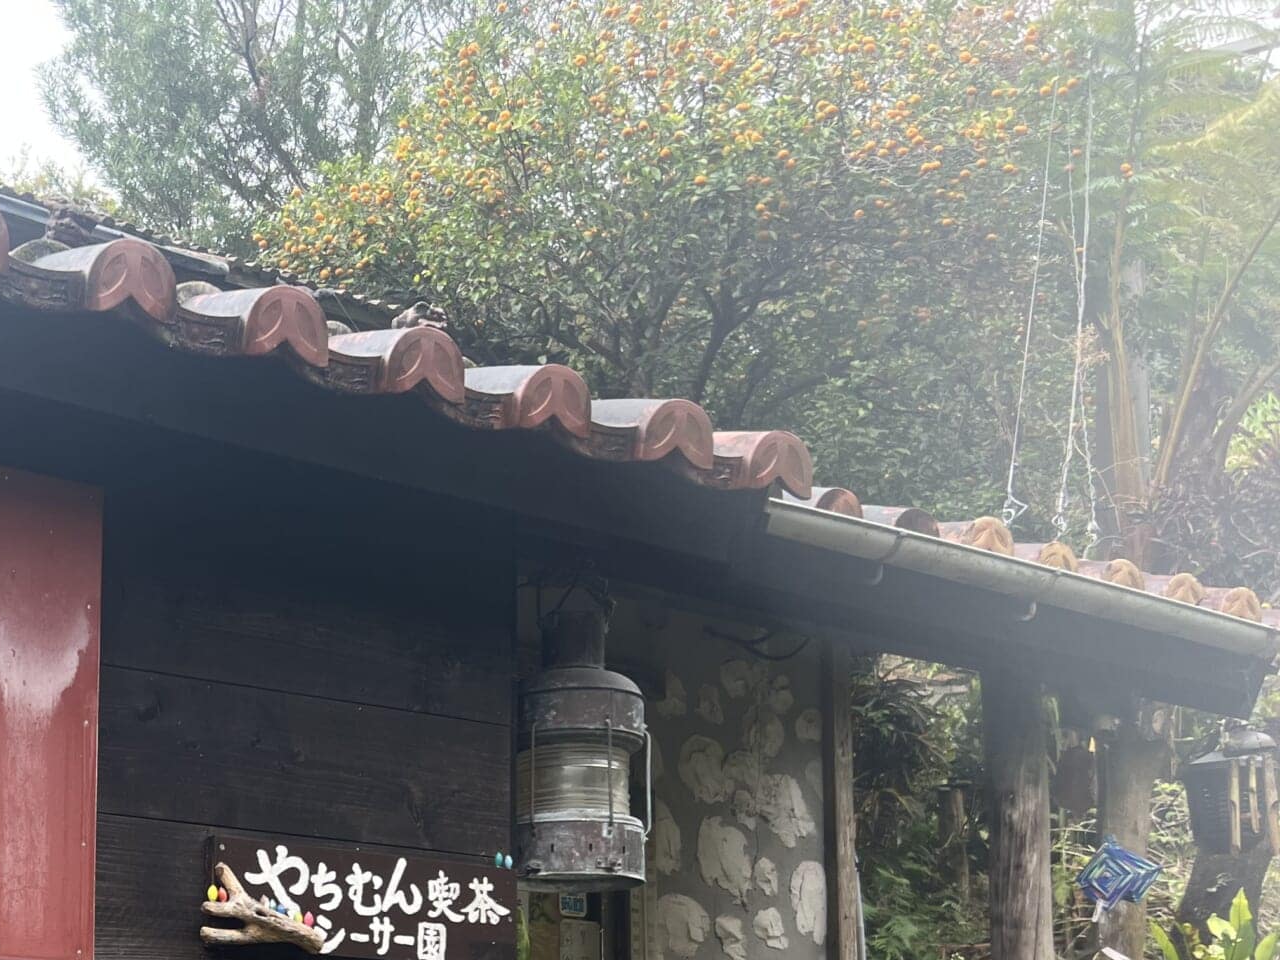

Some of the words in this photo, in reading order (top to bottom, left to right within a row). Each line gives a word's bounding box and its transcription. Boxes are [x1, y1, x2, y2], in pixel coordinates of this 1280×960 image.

[244, 844, 510, 924] やちむん喫茶
